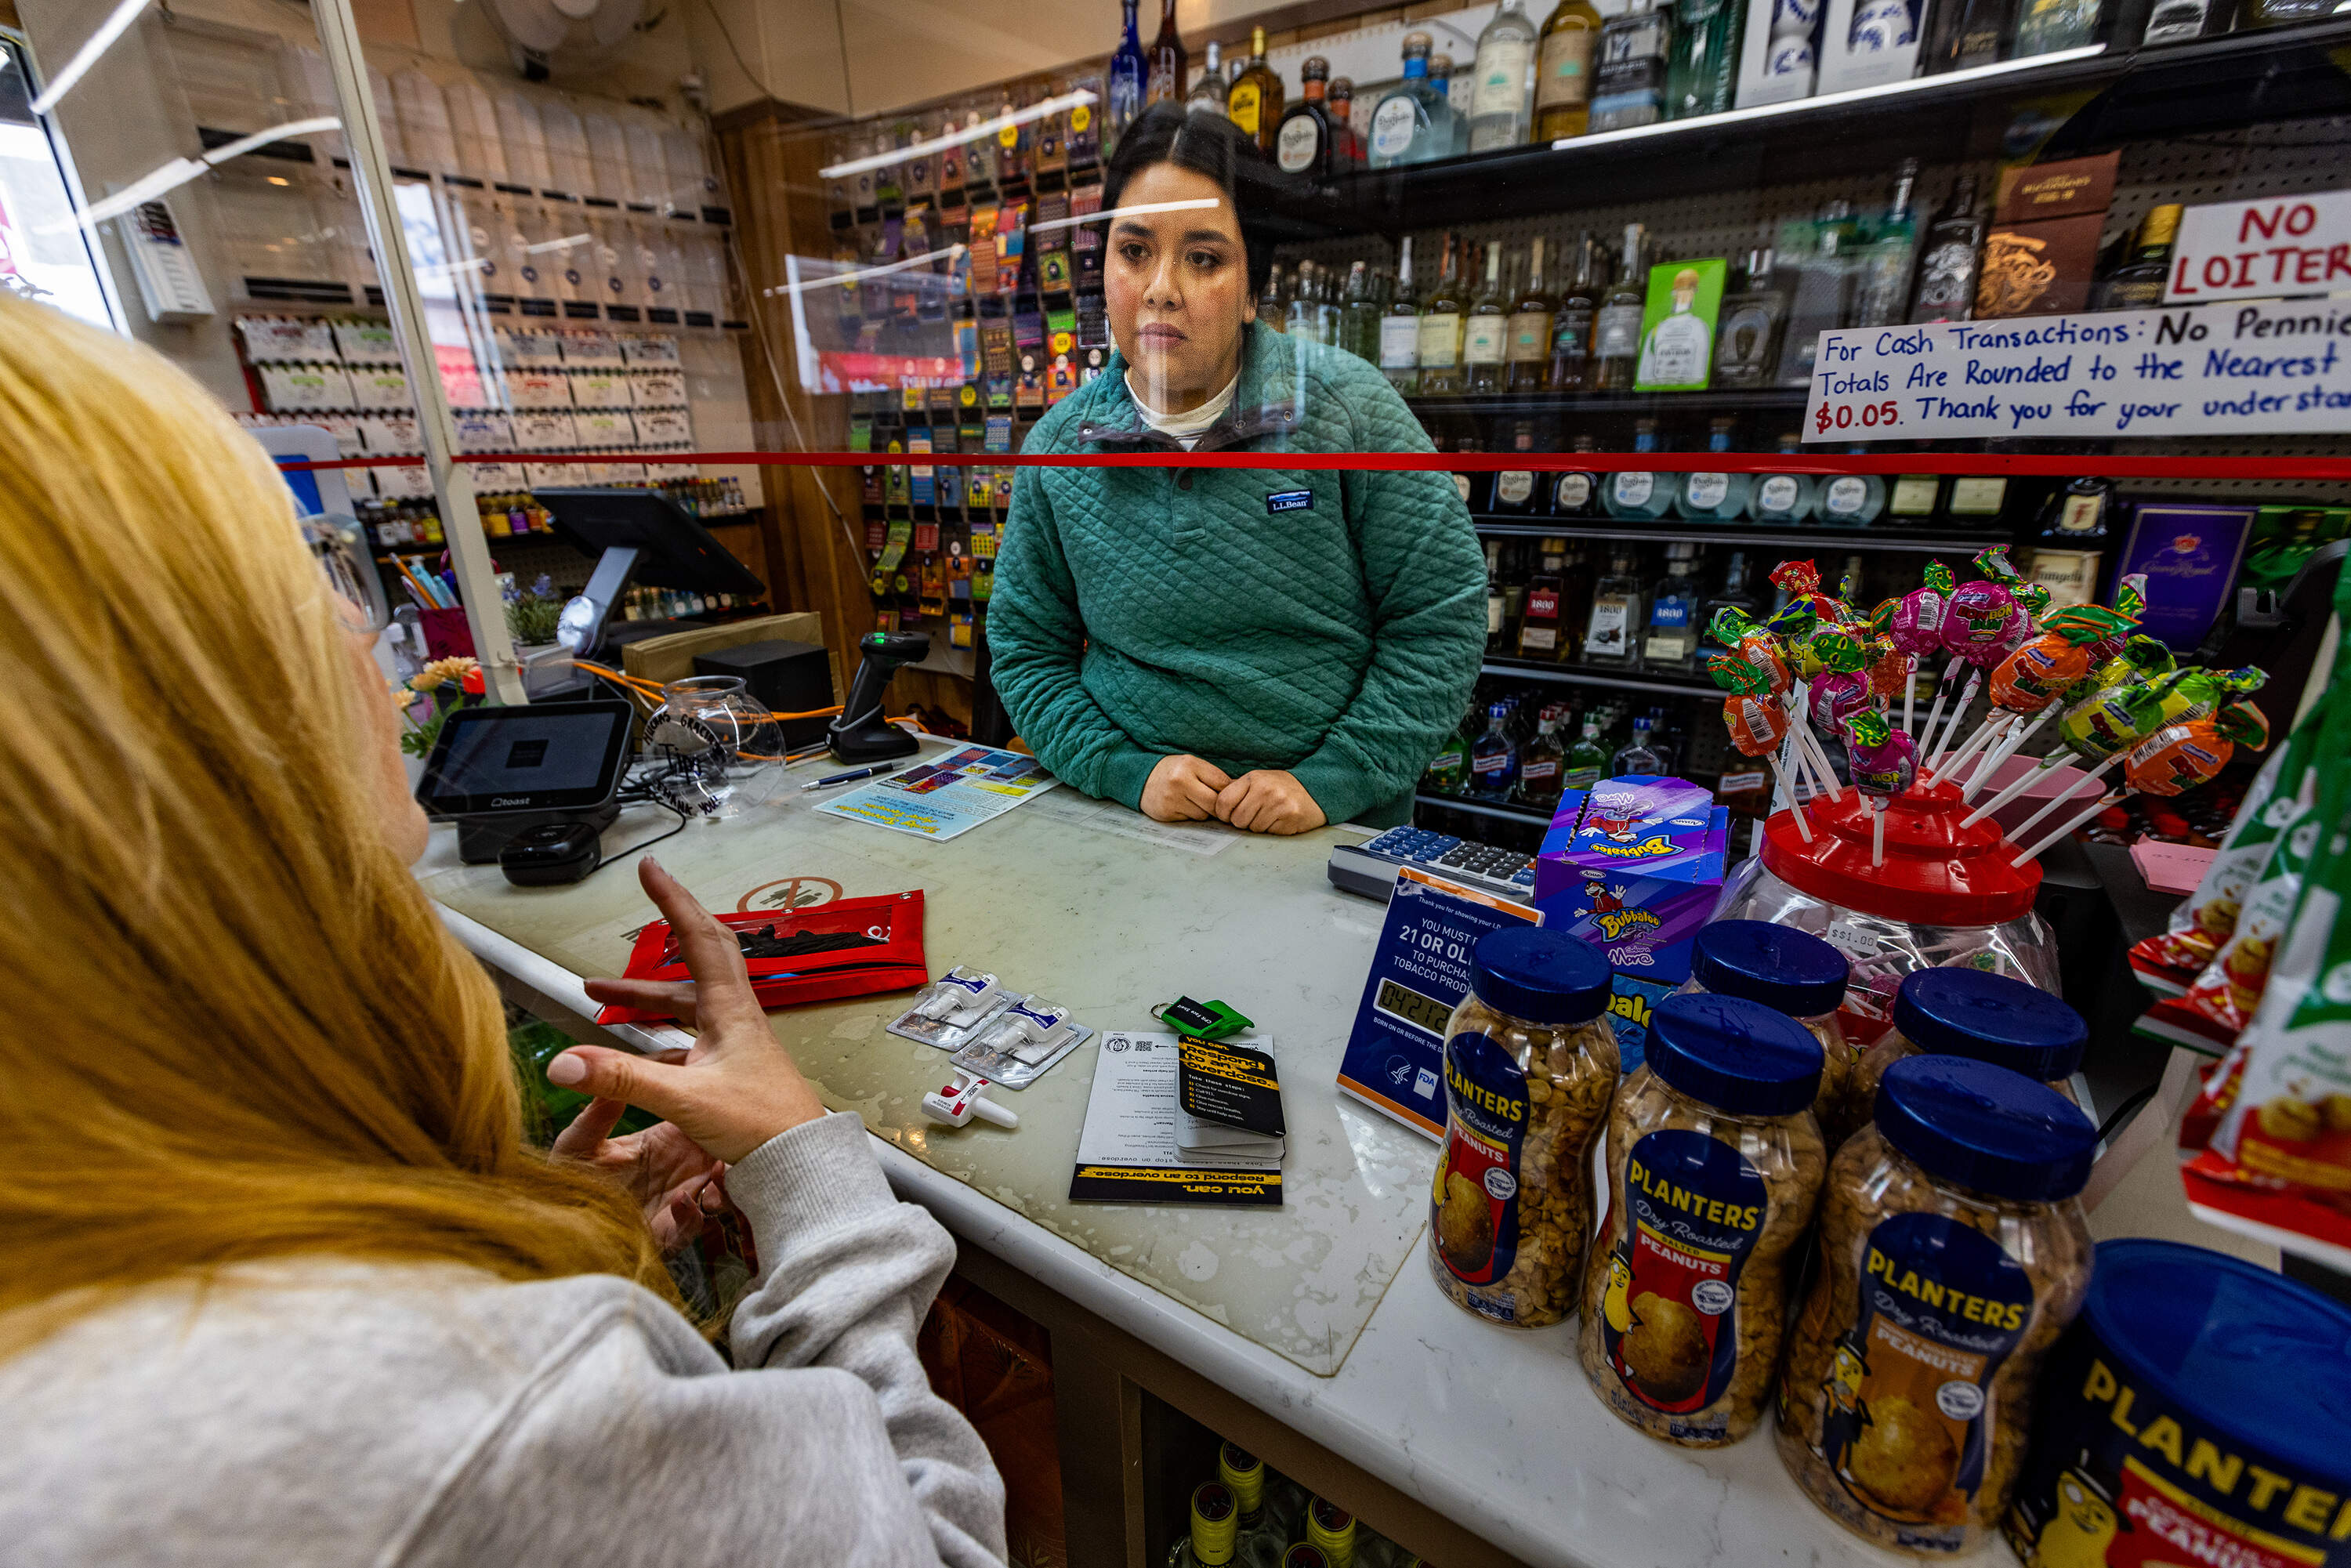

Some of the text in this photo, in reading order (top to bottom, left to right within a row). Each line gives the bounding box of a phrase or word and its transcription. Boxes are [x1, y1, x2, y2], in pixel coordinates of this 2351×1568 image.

[2237, 203, 2317, 244] NO
[2172, 242, 2351, 295] LOITER
[1825, 337, 1862, 361] For
[1875, 329, 1933, 357] Cash
[2155, 312, 2208, 346] No
[1818, 340, 2338, 397] Totals Are Rounded to the Nearest
[1815, 400, 1904, 435] $0.05.
[1915, 394, 2001, 420] Thank
[2009, 404, 2052, 430] you
[2064, 389, 2107, 418] for
[2116, 403, 2182, 430] your
[1531, 599, 1555, 610] 1800
[1599, 604, 1622, 614] 1800
[1657, 608, 1683, 618] 1800
[502, 797, 531, 806] toast
[1593, 837, 1675, 858] Bubbaloo
[1418, 896, 1435, 907] Thank
[1435, 903, 1445, 911] you
[1454, 910, 1478, 922] showing
[1478, 918, 1492, 927] your
[1422, 918, 1471, 943] YOU MUST
[1599, 909, 1660, 940] Bubbaloo
[1400, 925, 1418, 944] 21
[1420, 932, 1444, 954] OR
[1393, 955, 1437, 981] TOBACCO
[1412, 949, 1425, 962] TO
[1201, 1016, 1212, 1025] CPR
[1186, 1036, 1230, 1051] you can.
[1373, 1016, 1437, 1051] BORN ON OR BEFORE THE
[1183, 1052, 1205, 1063] to
[1210, 1059, 1231, 1069] an
[1186, 1045, 1259, 1068] Respond
[1187, 1062, 1271, 1086] overdose.
[1418, 1073, 1435, 1087] FDA
[1465, 1107, 1514, 1139] Roasted
[1454, 1121, 1504, 1163] PEANUTS
[1092, 1171, 1160, 1180] overdose.
[1183, 1173, 1200, 1182] to
[1201, 1173, 1265, 1182] Respond
[1182, 1184, 1265, 1195] you can.
[1630, 1158, 1760, 1232] PLANTERS
[1636, 1199, 1744, 1251] Dry Roasted
[1640, 1233, 1722, 1276] PEANUTS
[1661, 1236, 1701, 1256] SALTED
[1867, 1247, 2026, 1331] PLANTERS
[1876, 1327, 1976, 1378] PEANUTS
